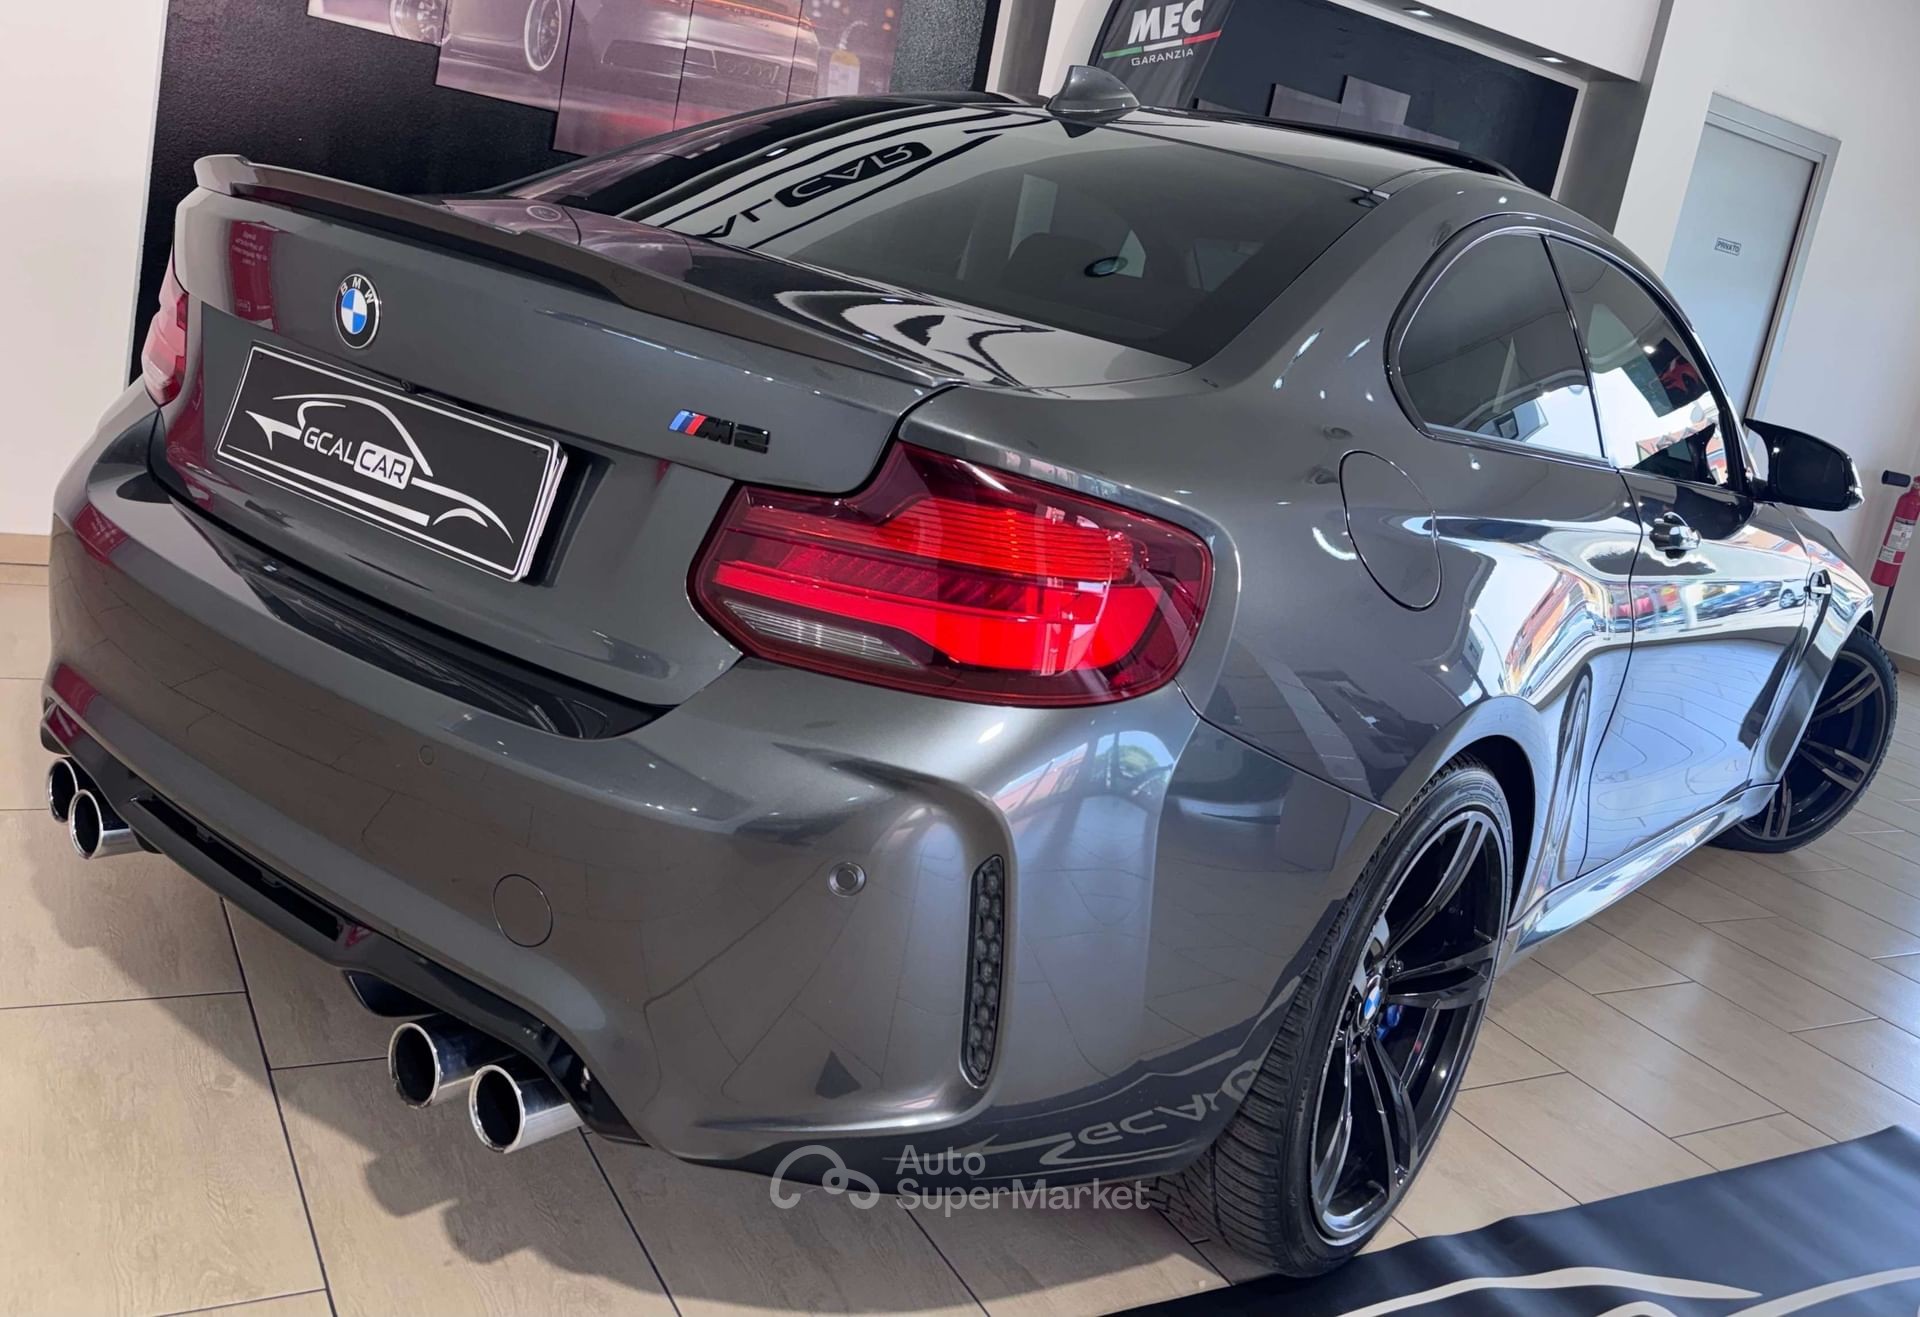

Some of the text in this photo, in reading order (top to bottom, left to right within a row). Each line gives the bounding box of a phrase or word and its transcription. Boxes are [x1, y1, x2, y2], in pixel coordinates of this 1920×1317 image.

[1127, 0, 1205, 45] MEC
[1131, 48, 1194, 66] GARANZIA
[340, 276, 375, 304] BMW
[694, 415, 771, 455] M2
